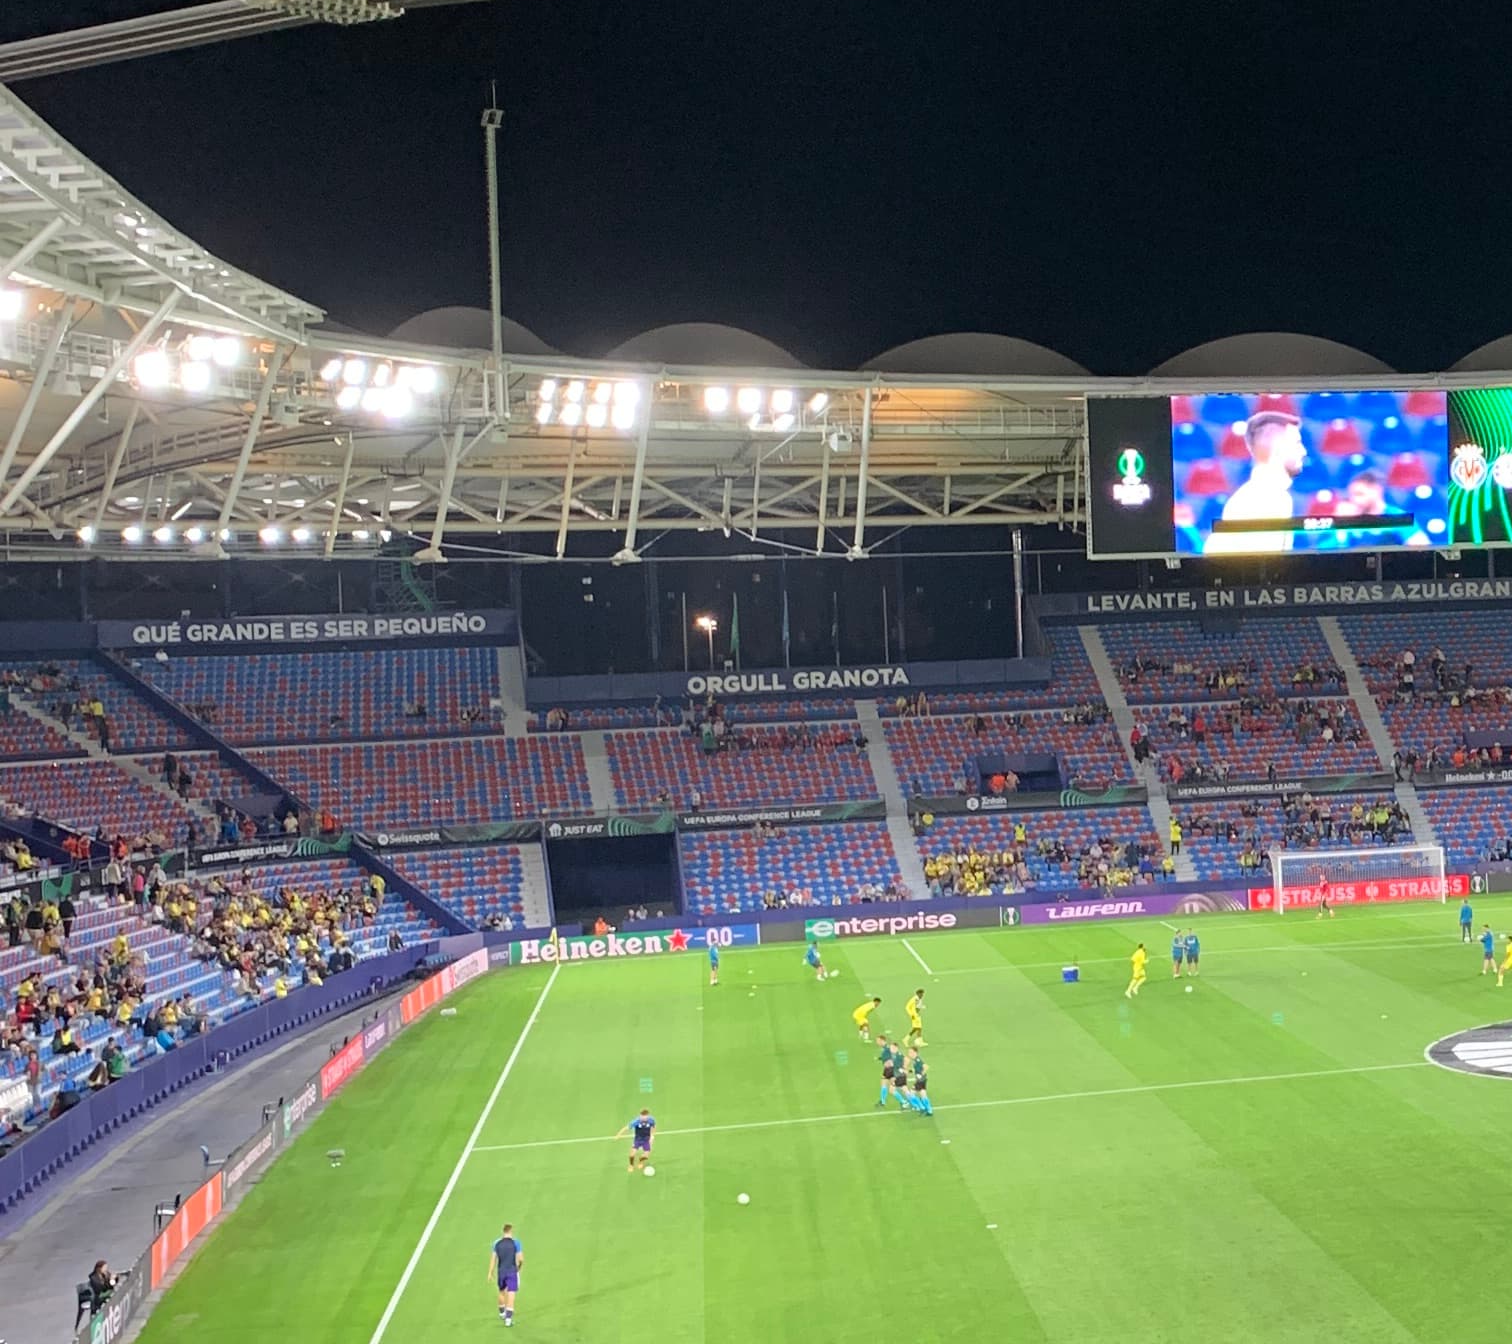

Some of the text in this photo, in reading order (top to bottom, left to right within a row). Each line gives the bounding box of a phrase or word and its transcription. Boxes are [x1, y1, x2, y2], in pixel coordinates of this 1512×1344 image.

[1087, 591, 1197, 612] LEVANTE,
[1205, 590, 1235, 606] EN
[1244, 588, 1286, 605] LAS
[1293, 584, 1383, 604] BARRAS
[132, 612, 486, 643] QUÉ GRANDE ES SER PEQUEÑO
[687, 667, 910, 695] ORGULL GRANOTA
[1226, 783, 1273, 794] CONFERENCE
[684, 809, 821, 825] UEFA EUROPA CONFERENCE LEAGUE
[389, 831, 440, 844] Swissquote
[564, 824, 604, 836] JUST EAT
[1389, 877, 1463, 897] STRAUSS
[812, 911, 956, 938] enterprise
[520, 937, 663, 964] Heineken
